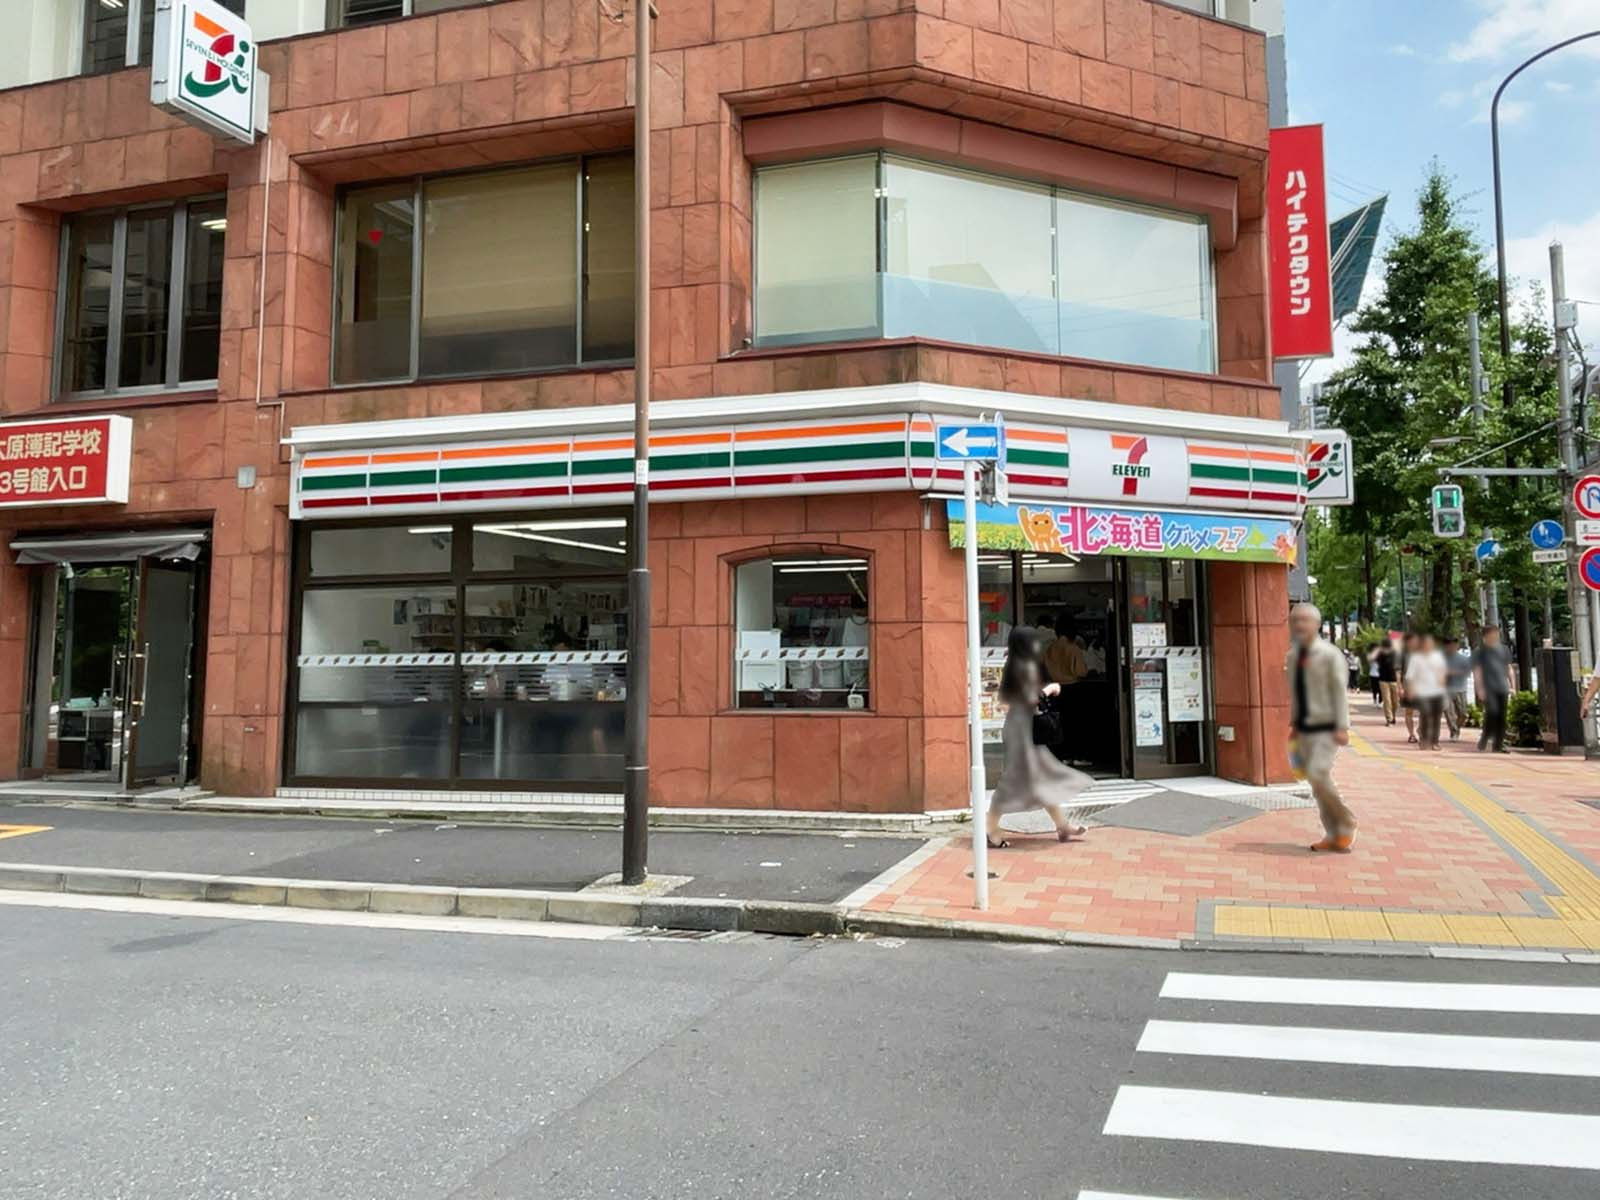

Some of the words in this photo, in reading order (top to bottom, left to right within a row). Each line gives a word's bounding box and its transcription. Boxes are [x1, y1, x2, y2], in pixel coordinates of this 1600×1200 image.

[1285, 171, 1311, 315] ハイテクタウン
[0, 465, 87, 494] 3号館入口
